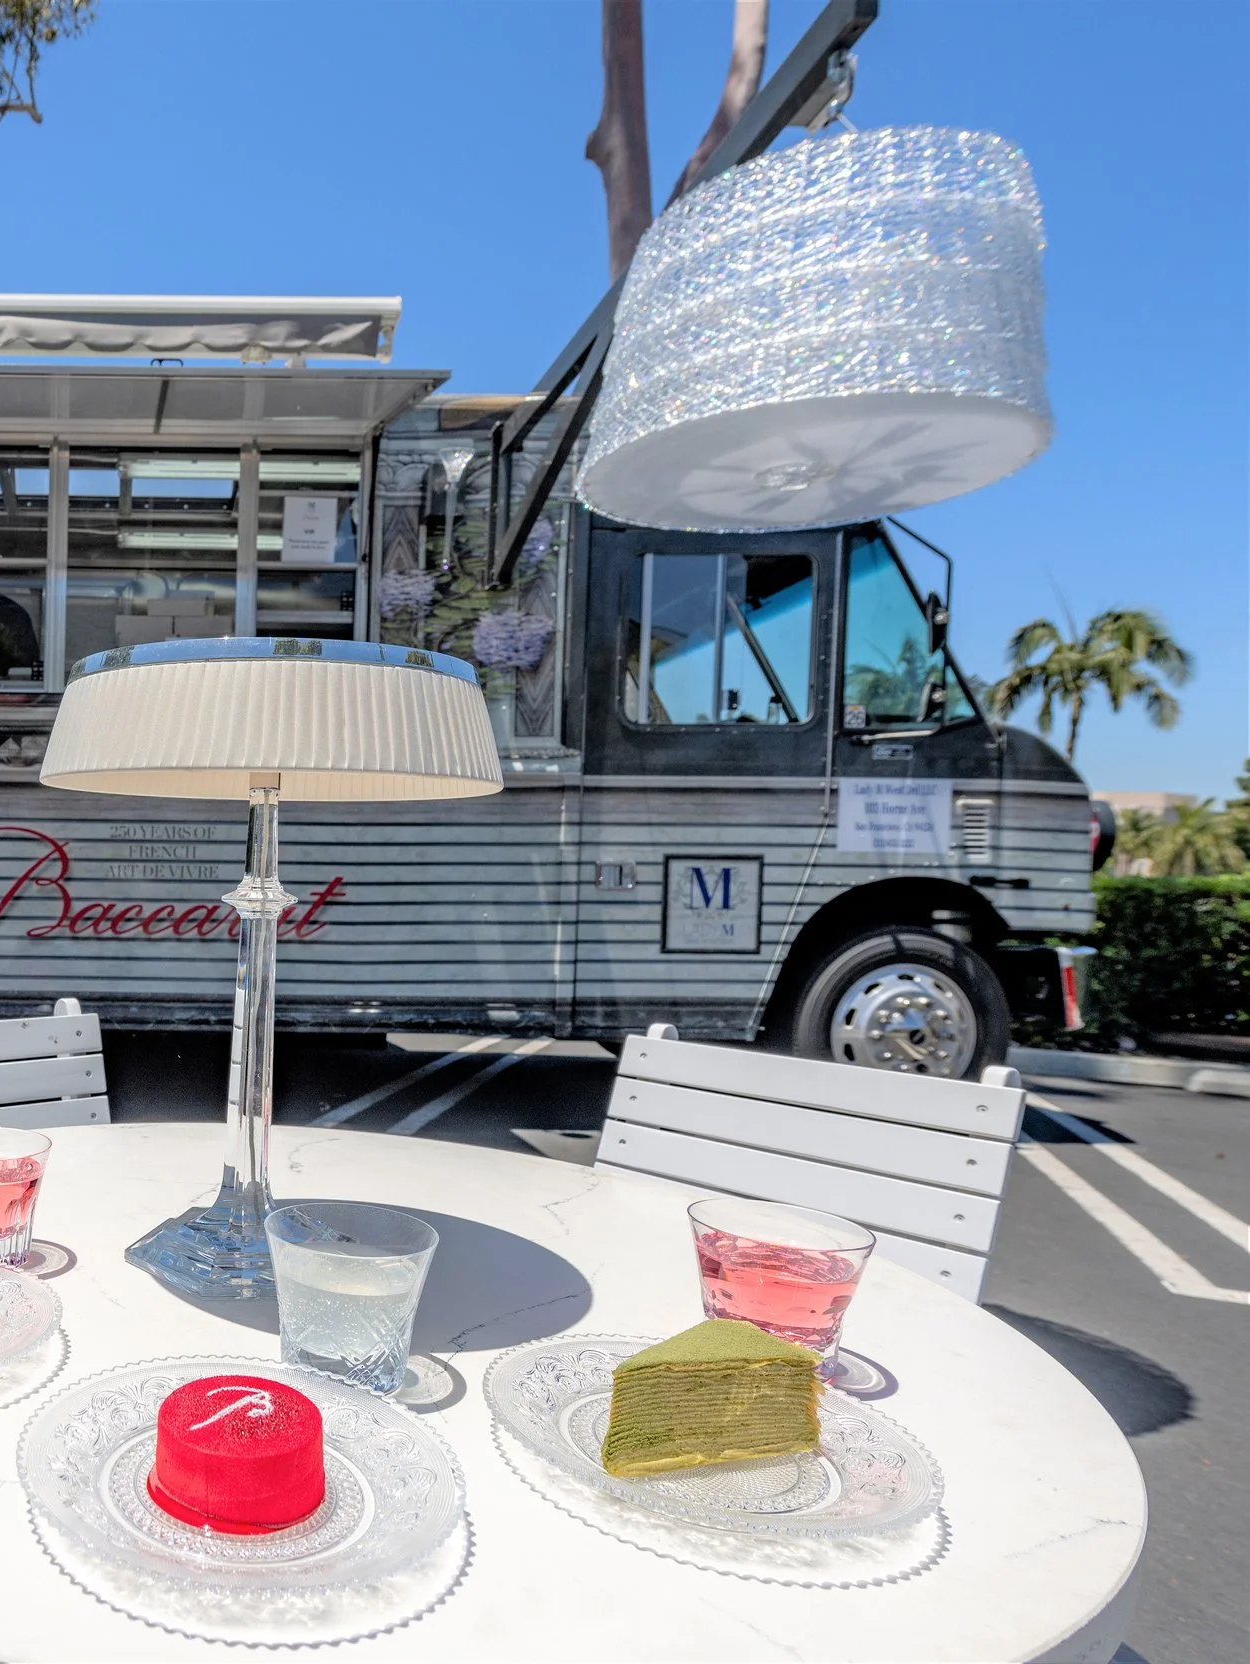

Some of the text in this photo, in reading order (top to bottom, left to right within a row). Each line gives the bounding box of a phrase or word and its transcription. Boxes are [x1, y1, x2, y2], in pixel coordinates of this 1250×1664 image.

[109, 825, 217, 840] 250 YEARS OF
[128, 845, 197, 859] FRENCH
[106, 864, 220, 879] ART DE VIVRE
[686, 867, 736, 910] M
